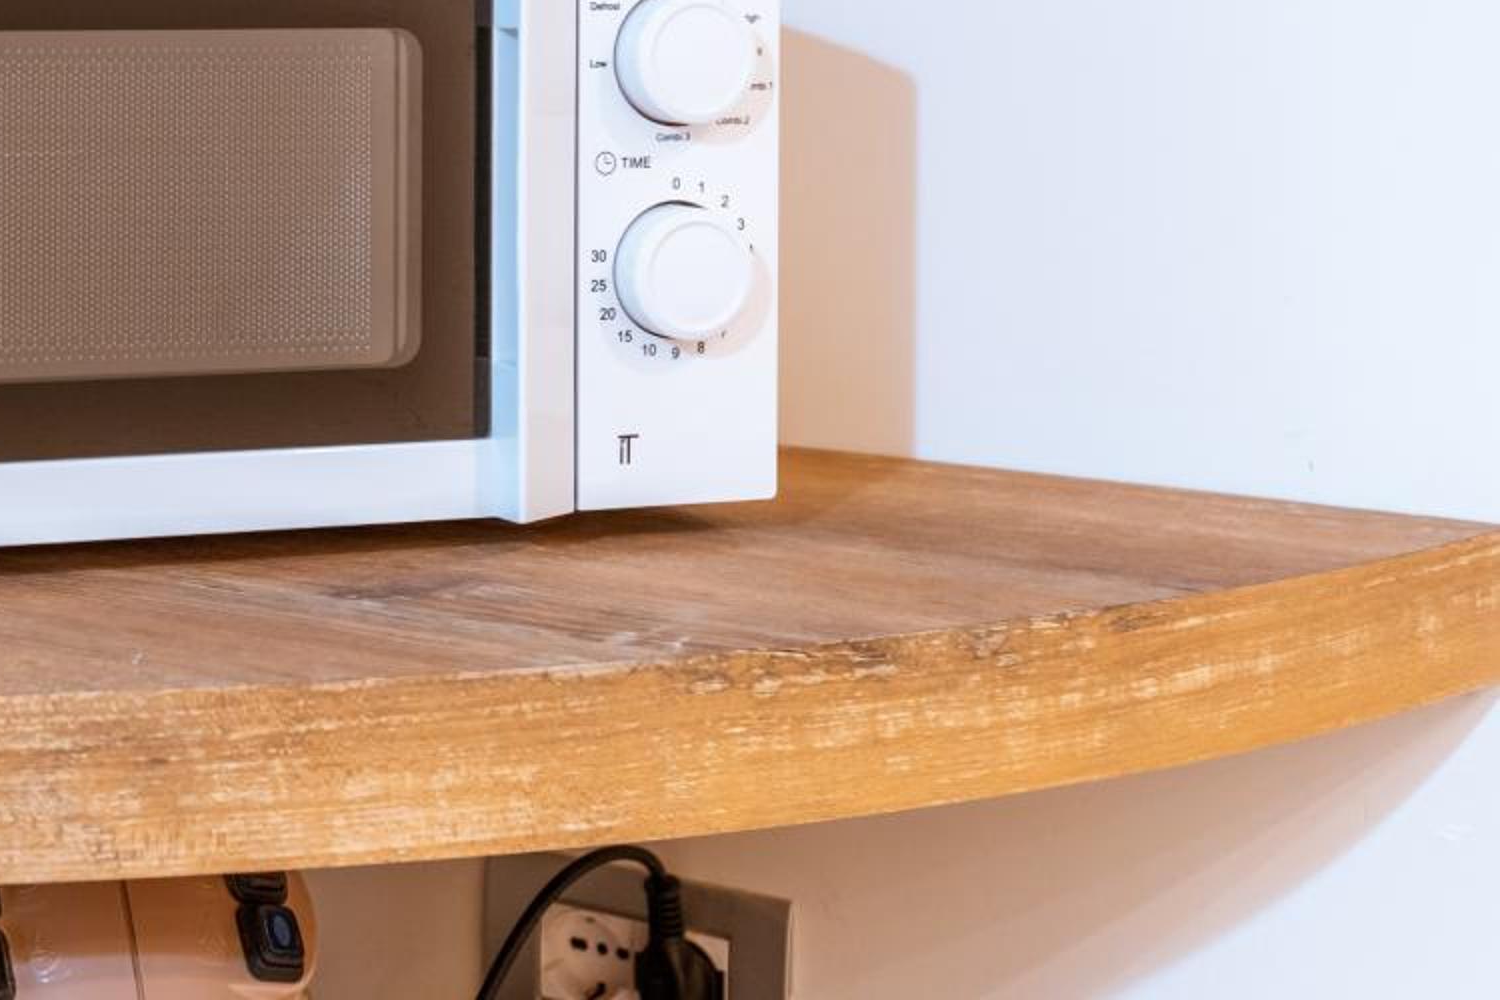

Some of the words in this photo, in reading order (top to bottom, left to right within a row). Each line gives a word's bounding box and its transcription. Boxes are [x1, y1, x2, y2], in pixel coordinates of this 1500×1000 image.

[621, 155, 651, 169] TIME
[672, 177, 681, 191] 0
[698, 180, 705, 193] 1
[720, 194, 730, 209] 2
[737, 217, 746, 232] 3
[591, 249, 608, 264] 30
[590, 278, 608, 293] 25
[599, 306, 617, 321] 20
[617, 329, 634, 343] 15
[642, 343, 657, 357] 10
[670, 345, 681, 360] 9
[696, 340, 706, 355] 8
